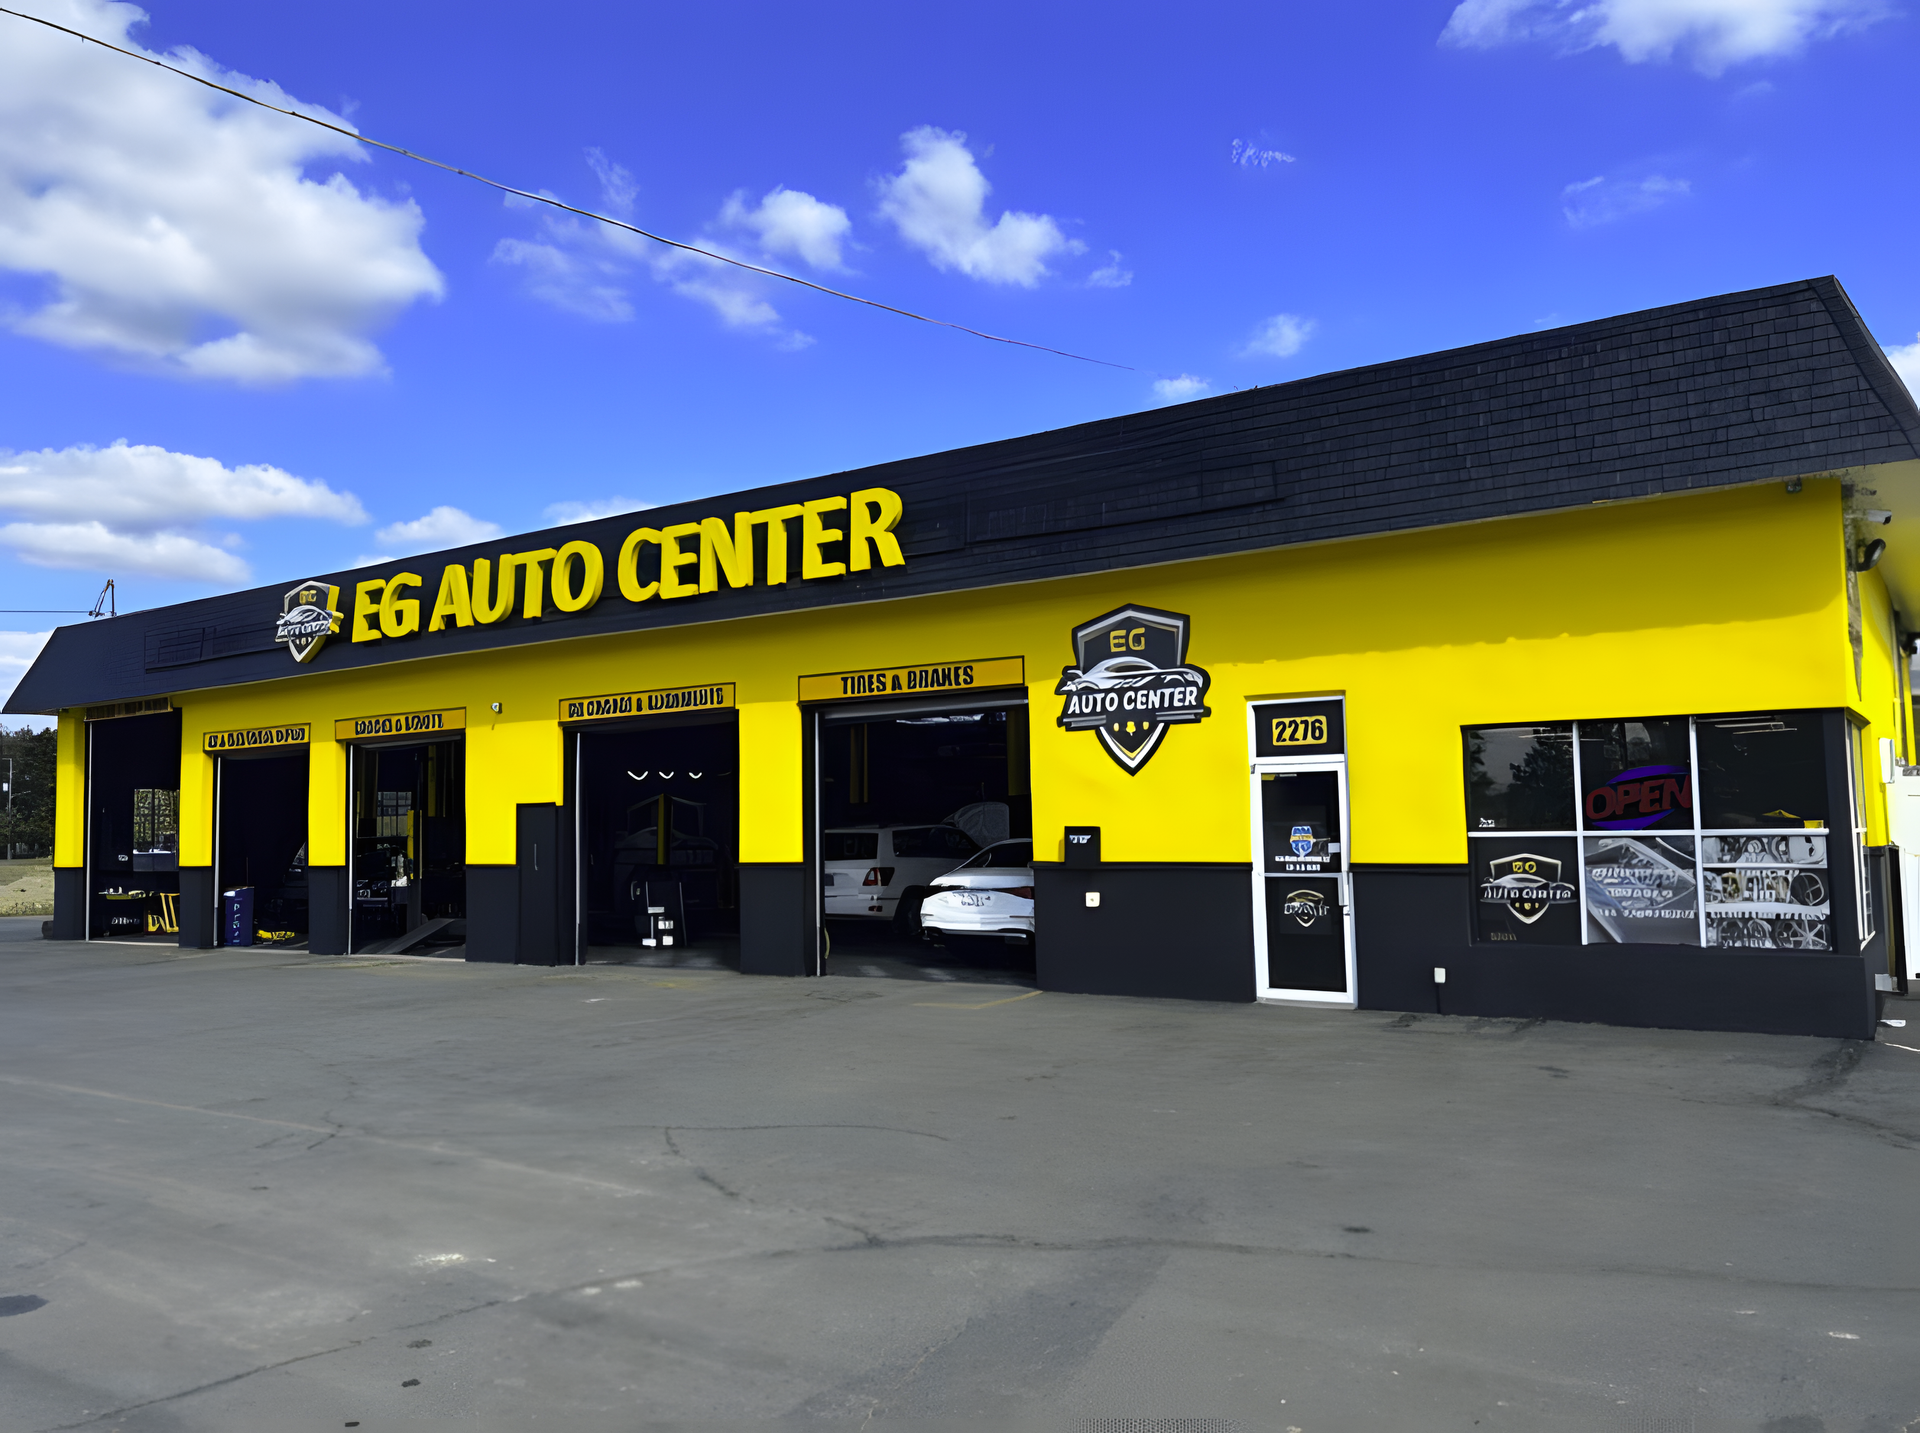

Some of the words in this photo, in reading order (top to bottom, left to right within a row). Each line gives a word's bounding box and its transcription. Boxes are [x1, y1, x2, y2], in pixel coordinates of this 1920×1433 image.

[352, 572, 423, 643] EG
[428, 540, 604, 632] AUTO
[617, 487, 906, 603] CENTER
[1109, 627, 1146, 652] EG
[1067, 692, 1119, 714] AUTO
[1123, 686, 1198, 710] CENTER
[1275, 718, 1324, 743] 2276
[1586, 774, 1692, 820] OPEN
